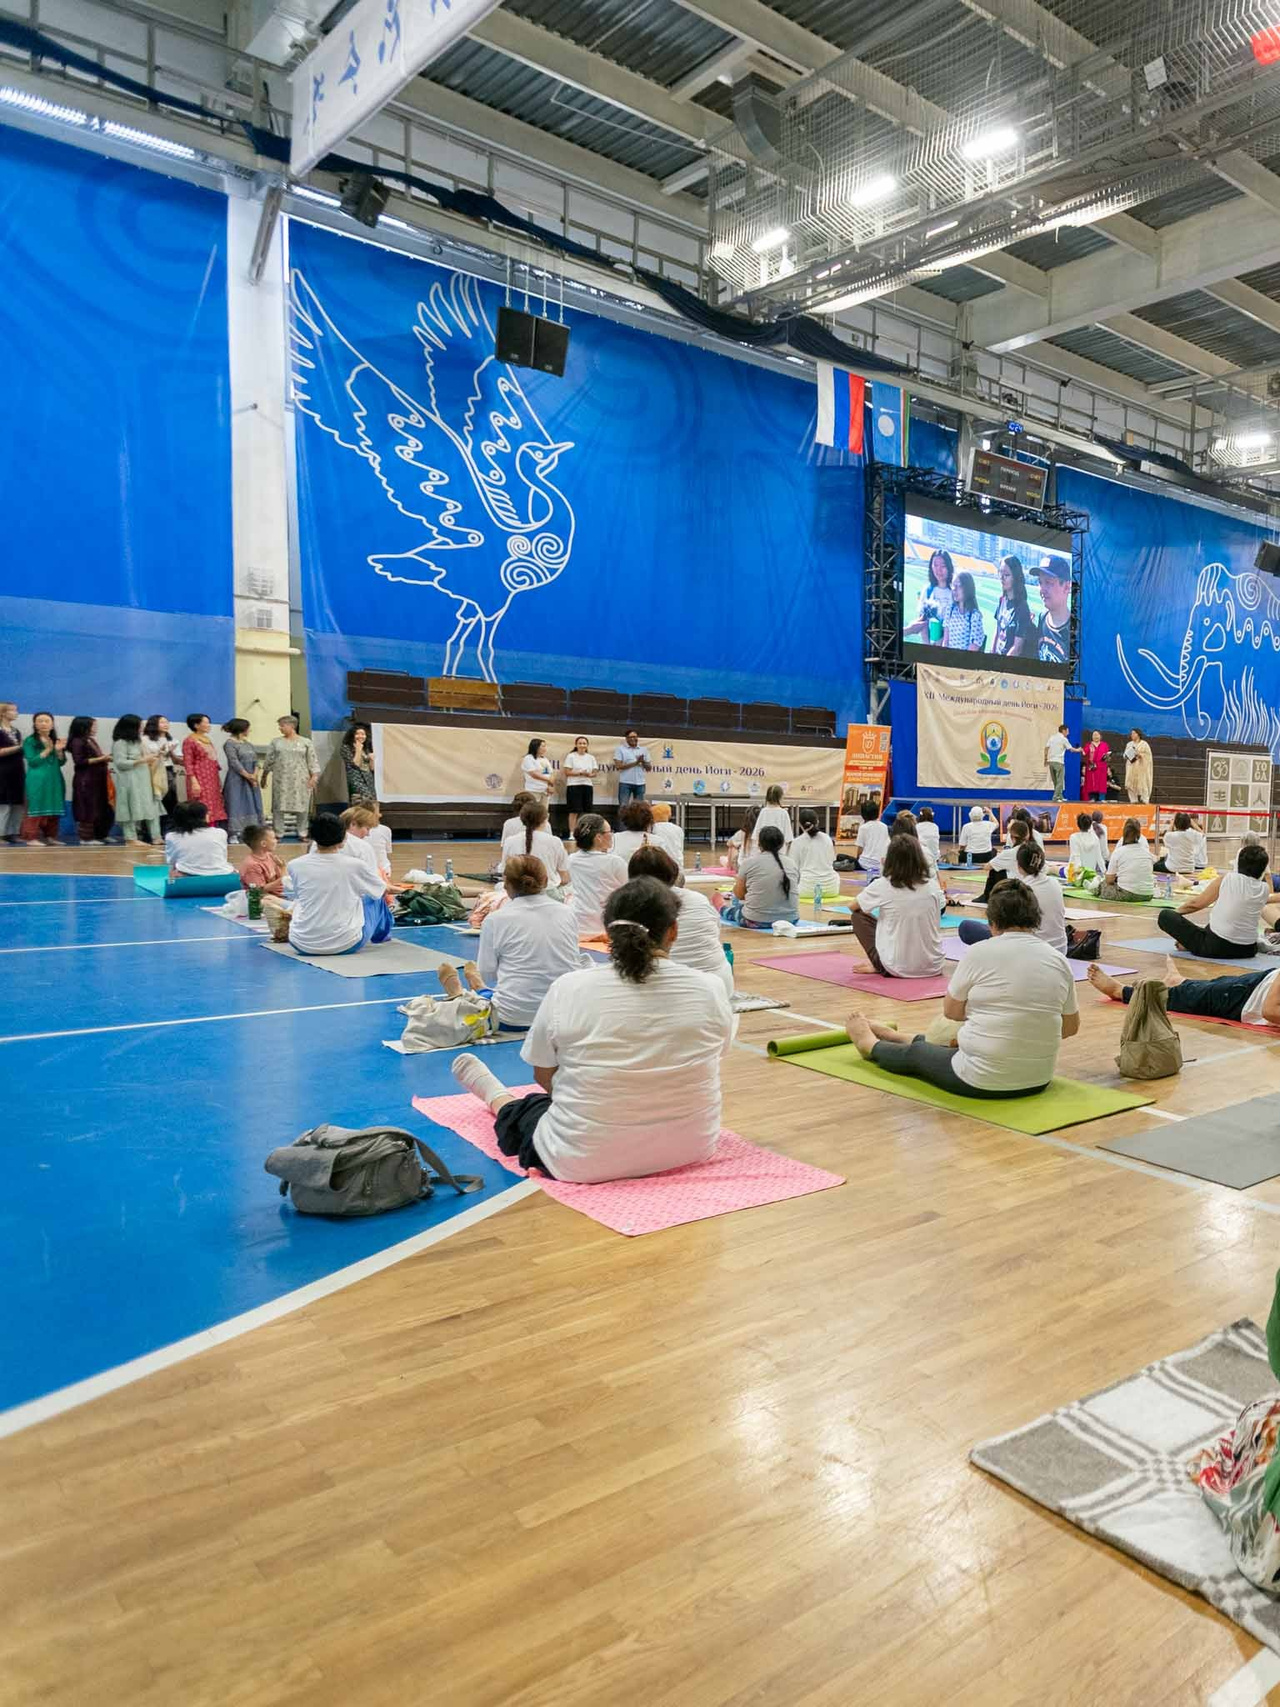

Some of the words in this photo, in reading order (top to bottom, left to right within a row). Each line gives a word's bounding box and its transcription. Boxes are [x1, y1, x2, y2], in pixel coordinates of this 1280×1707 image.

[674, 765, 702, 775] день
[705, 762, 731, 776] Йоги
[739, 765, 765, 777] 2026
